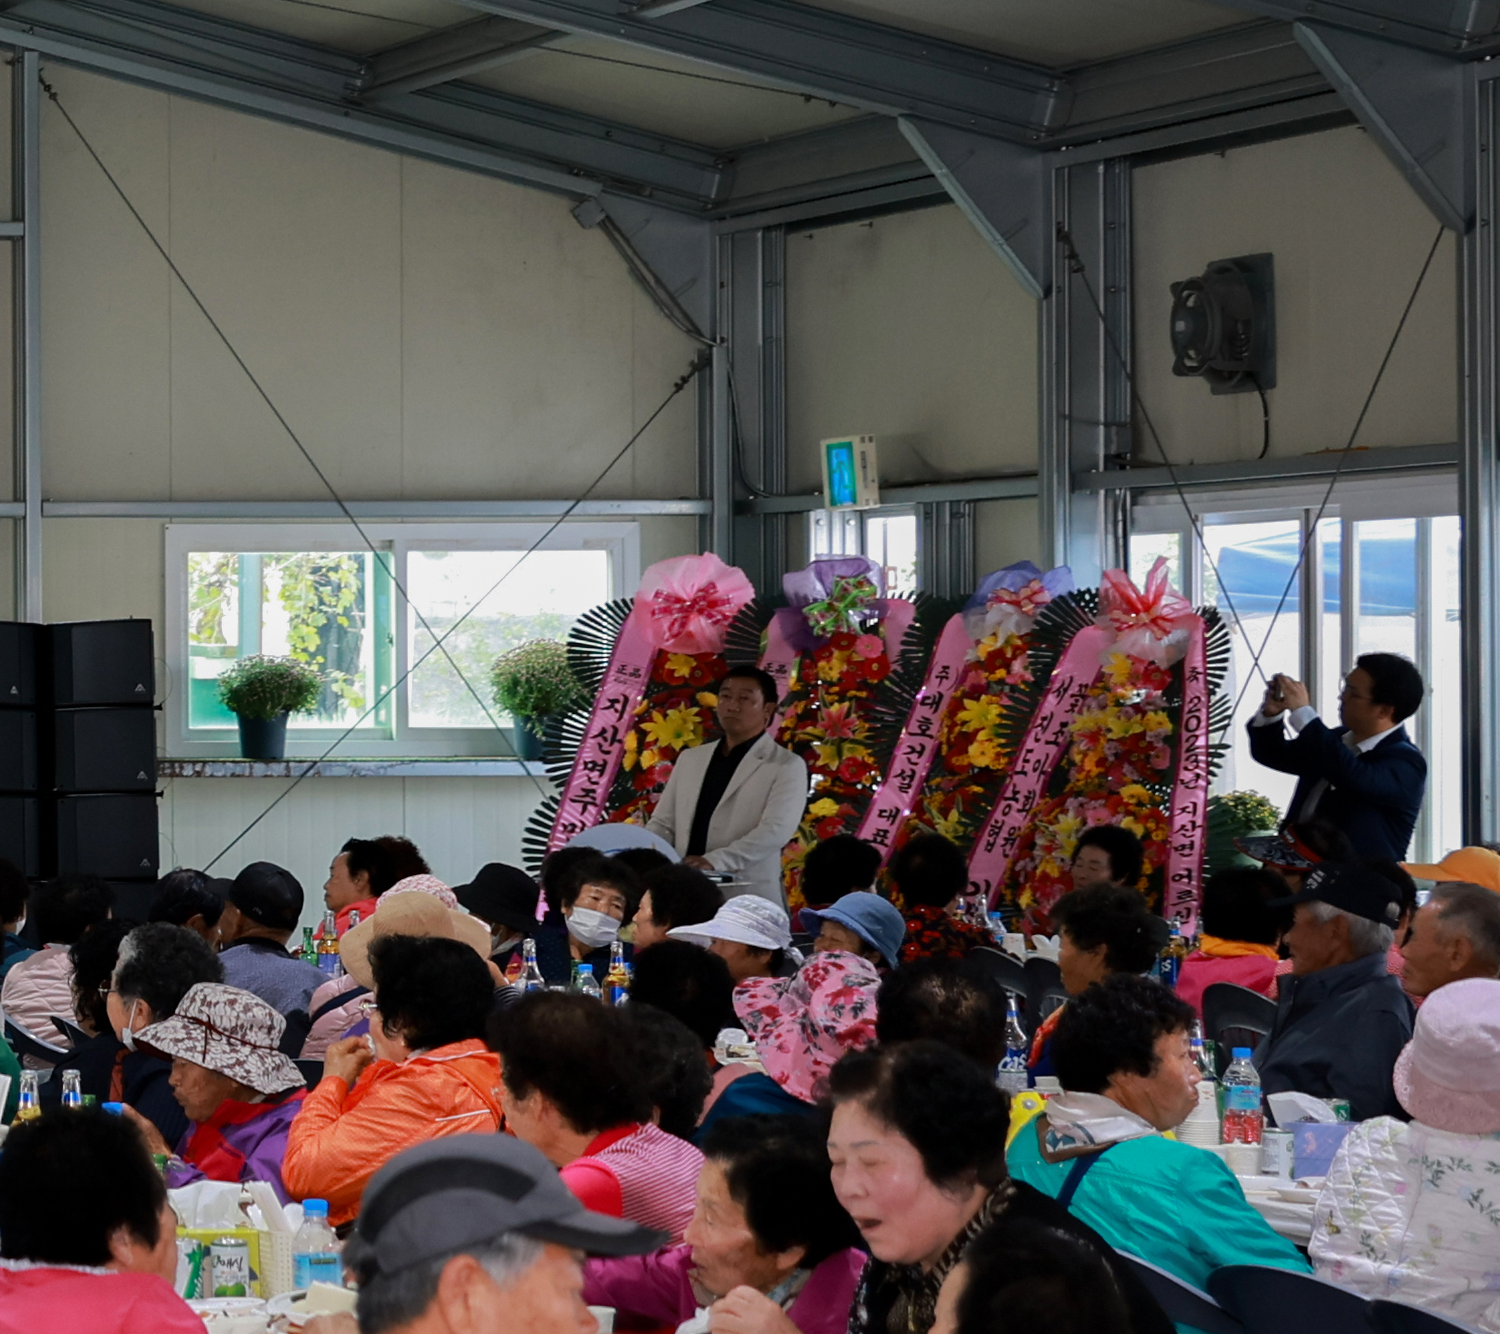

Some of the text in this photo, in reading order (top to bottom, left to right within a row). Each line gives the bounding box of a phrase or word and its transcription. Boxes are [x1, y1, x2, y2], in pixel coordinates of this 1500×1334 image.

[1179, 696, 1203, 790] 2023년
[863, 806, 901, 849] 대표
[1172, 802, 1203, 858] 지산면
[1171, 867, 1200, 924] 어르신
